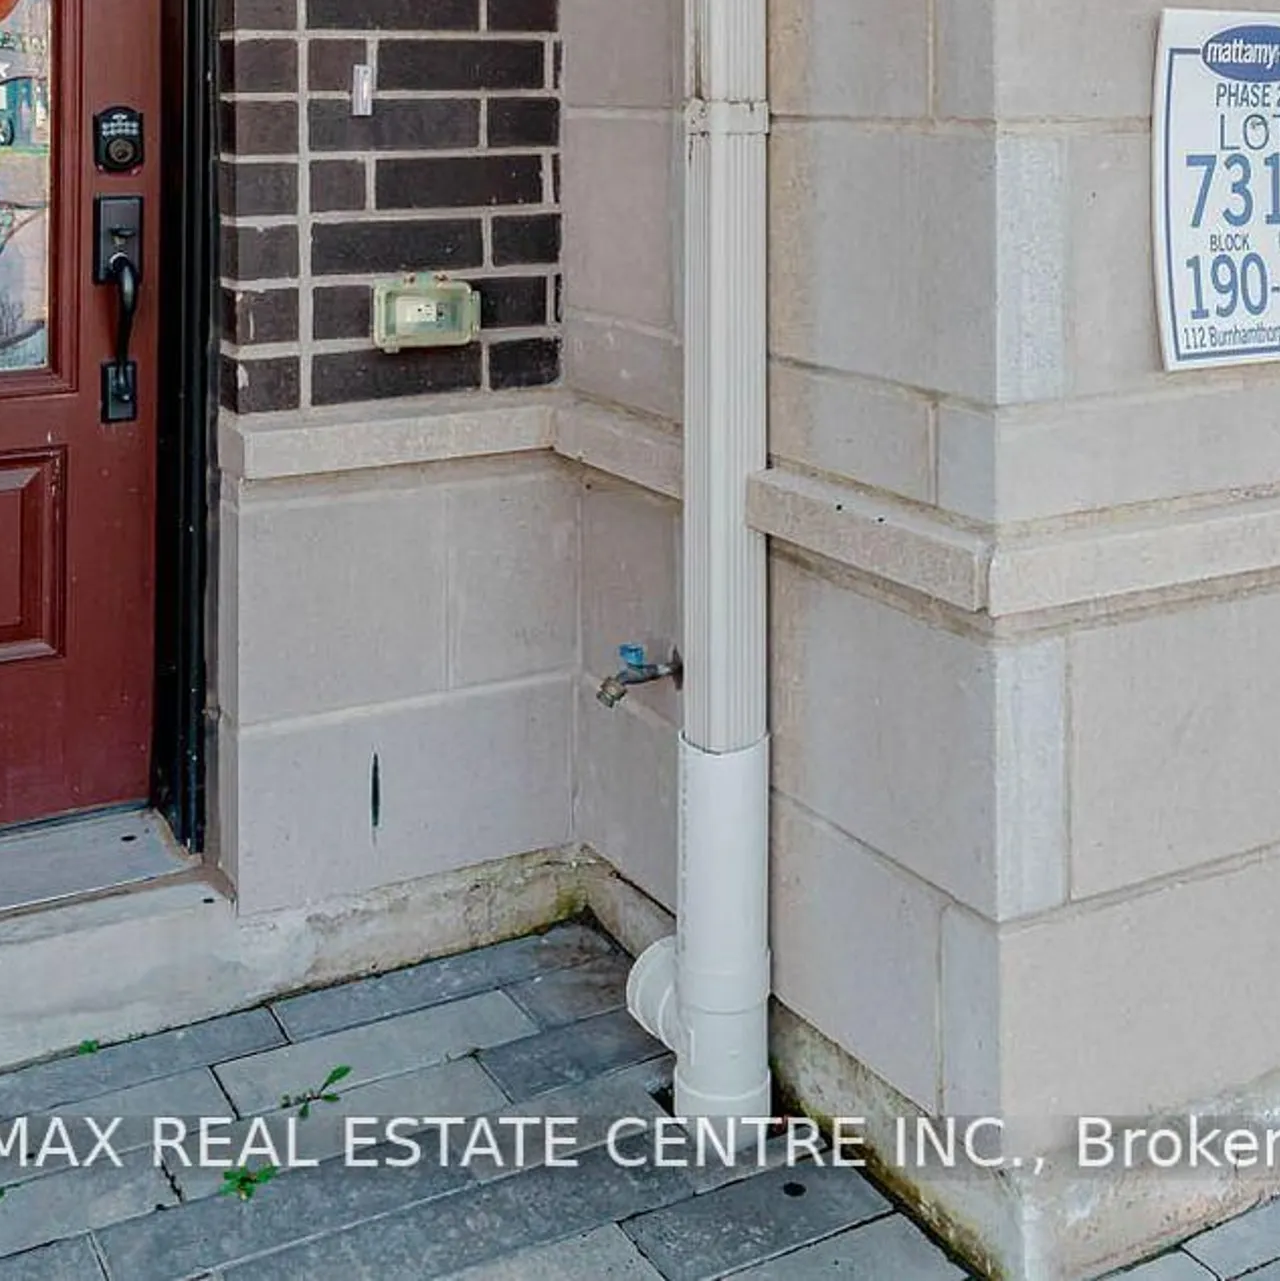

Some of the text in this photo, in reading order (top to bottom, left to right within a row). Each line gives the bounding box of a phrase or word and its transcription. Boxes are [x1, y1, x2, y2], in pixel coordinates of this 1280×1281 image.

[1216, 83, 1270, 108] PHASE
[1209, 233, 1251, 252] BLOCK
[1183, 327, 1206, 349] 112
